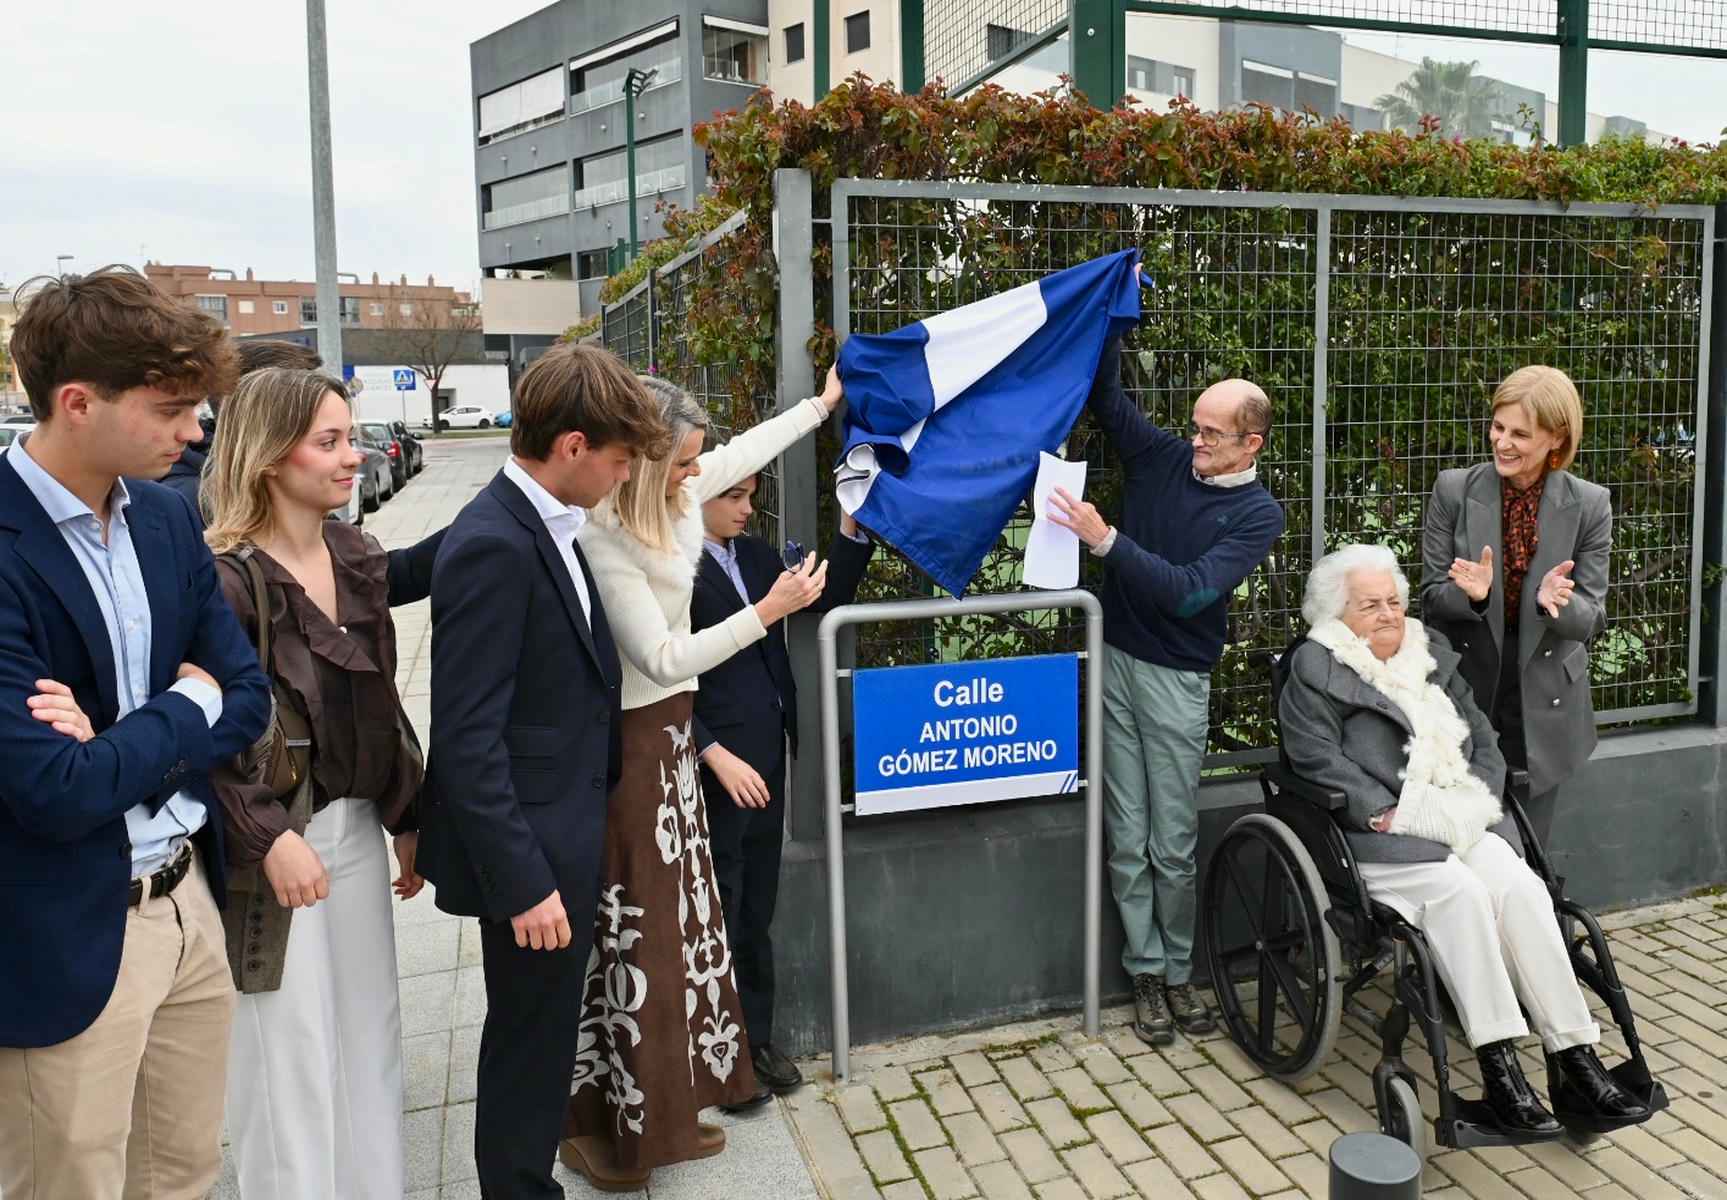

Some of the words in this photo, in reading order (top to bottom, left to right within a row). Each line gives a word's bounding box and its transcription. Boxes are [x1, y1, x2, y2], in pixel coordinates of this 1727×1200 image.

[933, 677, 1004, 708] Calle
[919, 714, 1018, 743] ANTONIO
[878, 748, 959, 777] GÓMEZ
[963, 739, 1058, 769] MORENO
